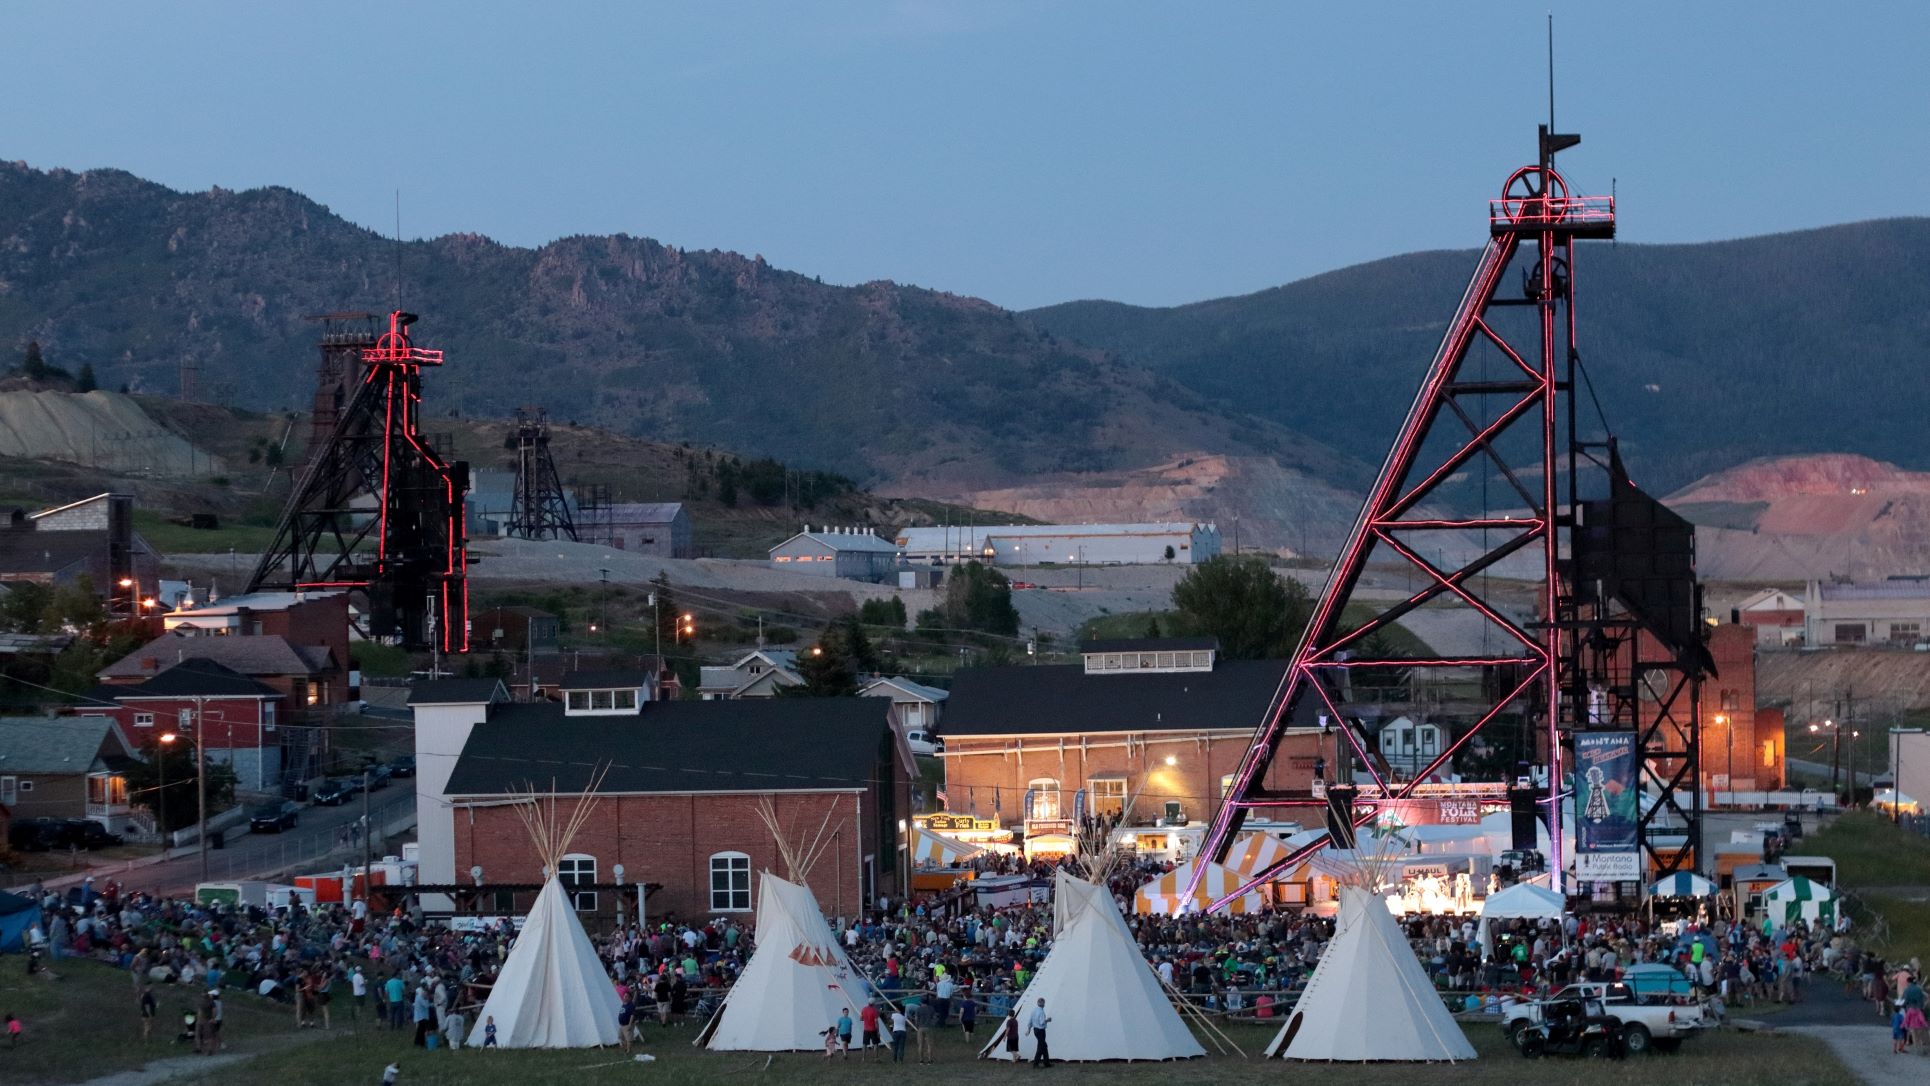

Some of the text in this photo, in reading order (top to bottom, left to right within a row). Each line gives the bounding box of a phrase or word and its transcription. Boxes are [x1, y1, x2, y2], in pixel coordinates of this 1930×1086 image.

[1440, 801, 1477, 809] MONTANA
[1441, 808, 1477, 817] FOLK
[1593, 854, 1633, 863] Montana
